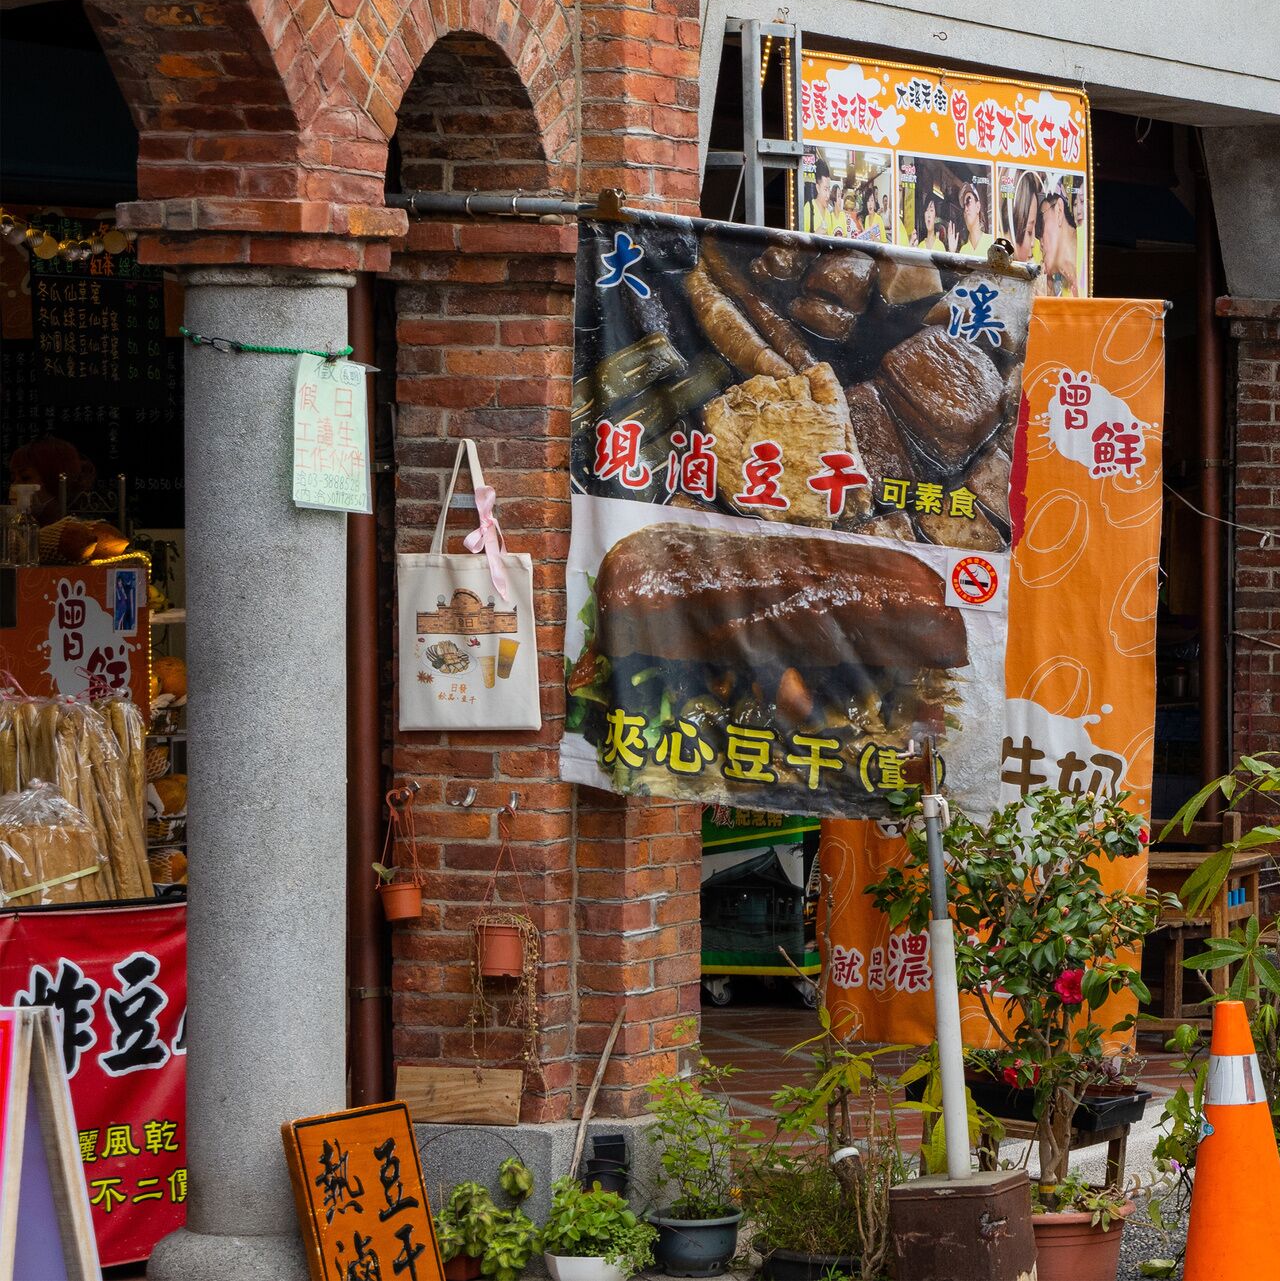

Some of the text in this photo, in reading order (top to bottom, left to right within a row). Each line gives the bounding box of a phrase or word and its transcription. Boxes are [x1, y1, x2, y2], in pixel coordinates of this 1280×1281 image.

[951, 90, 1080, 163] 曾鮮木瓜牛奶
[1058, 371, 1145, 478] 曾鮮
[881, 477, 978, 520] 可素食
[16, 952, 187, 1078] 炸豆
